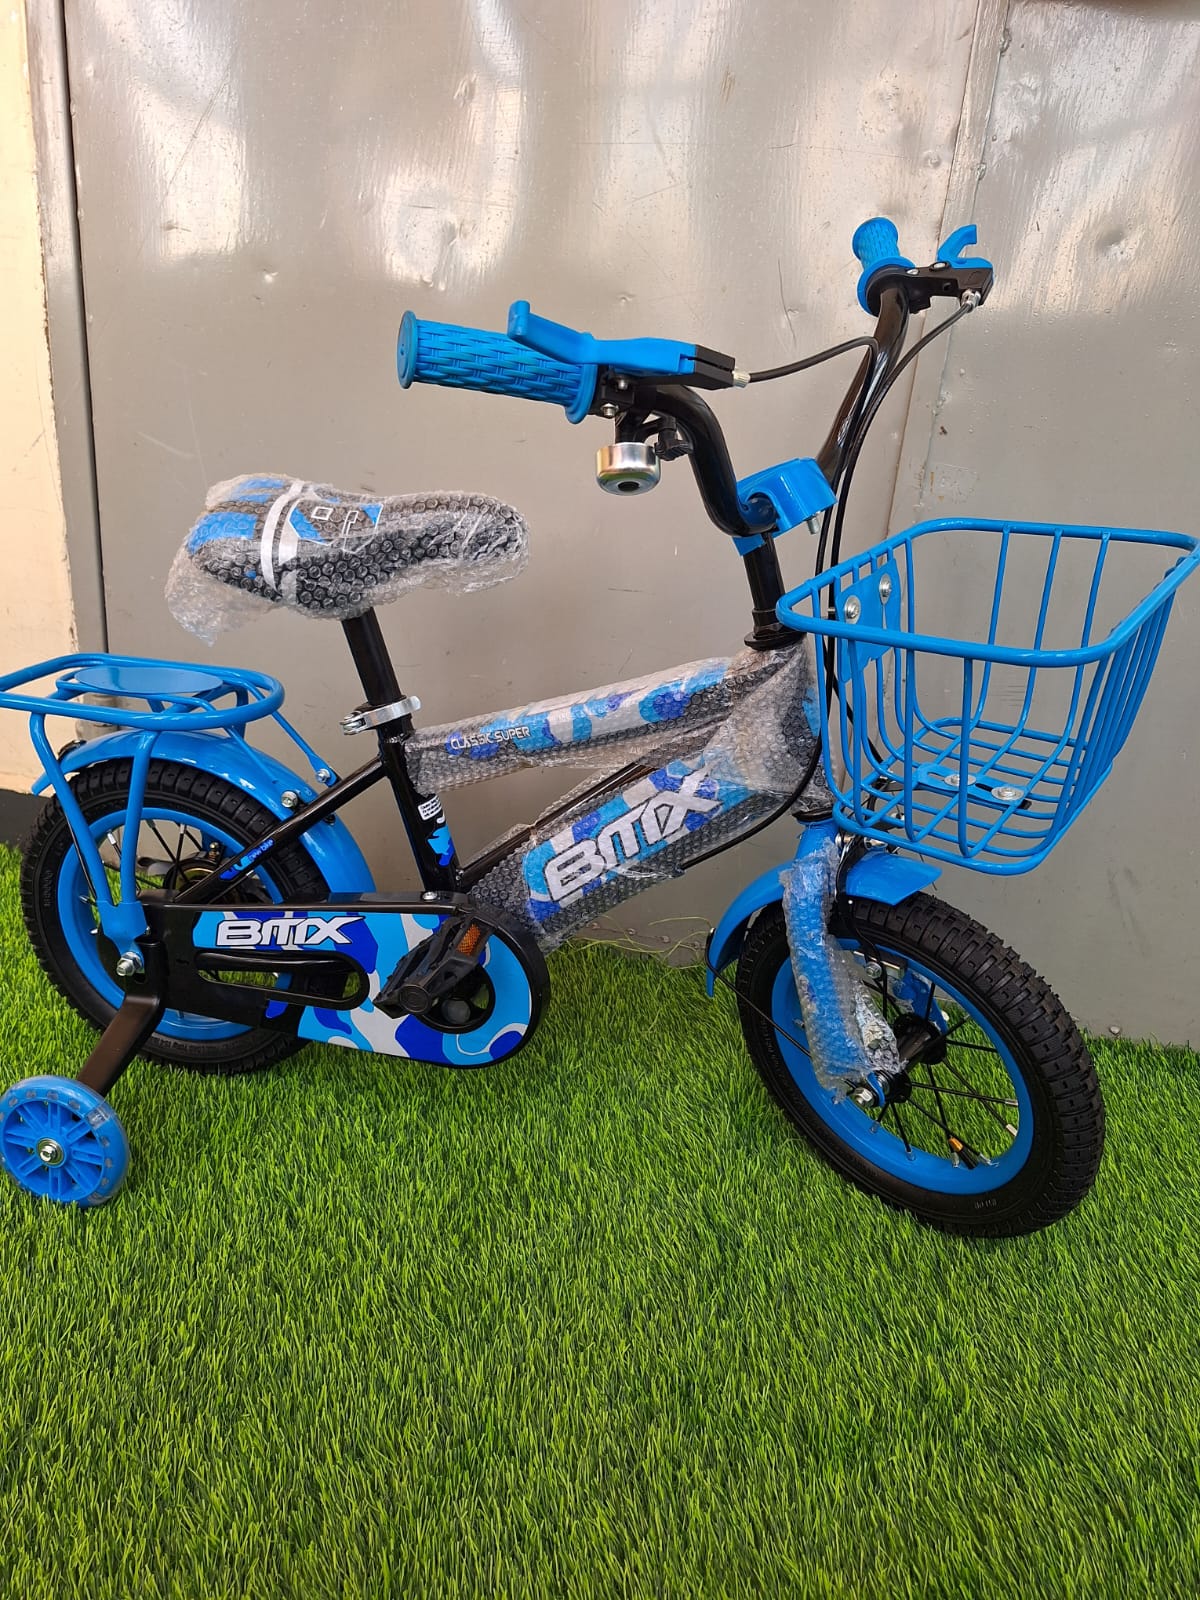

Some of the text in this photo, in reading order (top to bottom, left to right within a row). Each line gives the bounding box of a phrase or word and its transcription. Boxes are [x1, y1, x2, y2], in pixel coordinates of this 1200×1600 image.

[494, 726, 531, 743] SUPER
[543, 764, 723, 902] BMX
[216, 916, 366, 946] BMX
